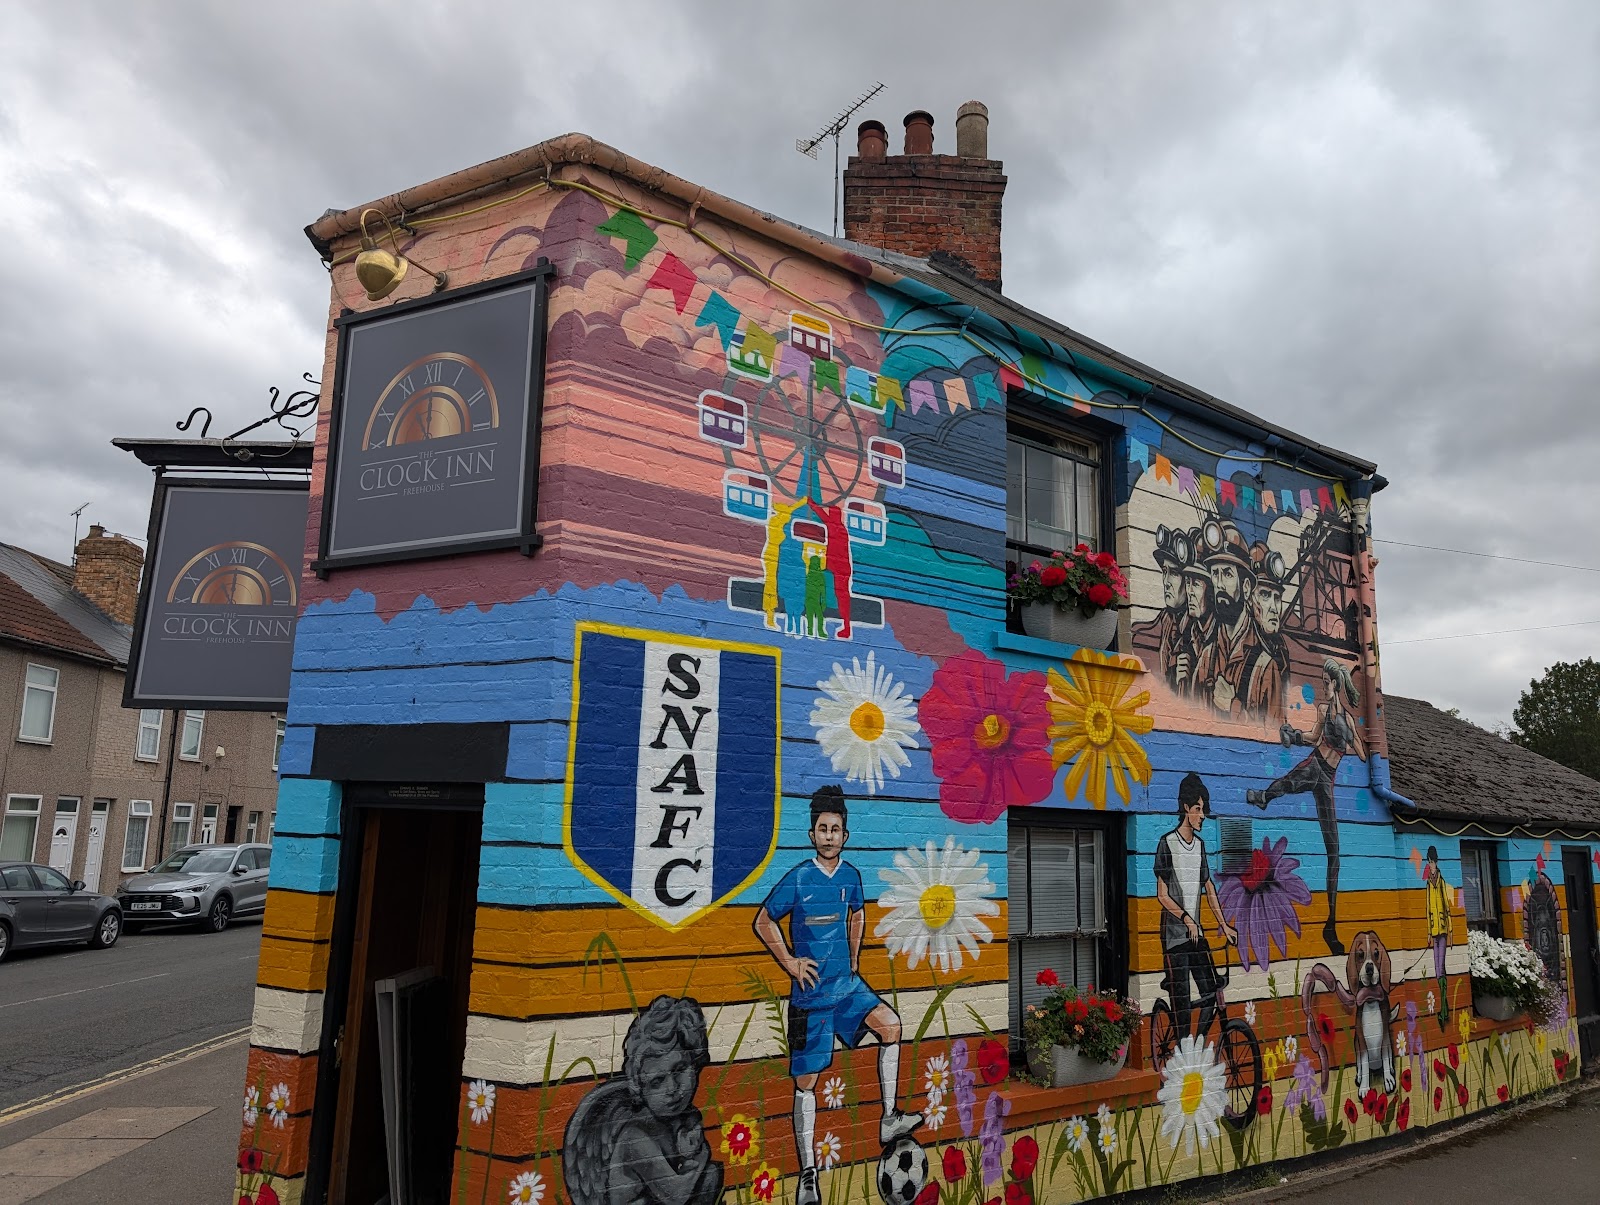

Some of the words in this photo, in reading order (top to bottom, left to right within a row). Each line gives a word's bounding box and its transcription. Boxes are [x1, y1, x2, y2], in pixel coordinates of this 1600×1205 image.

[398, 374, 416, 400] XI
[424, 361, 443, 385] XII
[452, 366, 465, 387] I
[467, 387, 486, 407] II
[360, 458, 439, 491] CLOCK
[446, 448, 496, 479] INN
[419, 450, 434, 460] THE
[403, 483, 446, 496] FREEHOUSE
[205, 552, 221, 571] XI
[229, 548, 248, 564] XII
[256, 555, 268, 570] I
[269, 574, 286, 587] II
[163, 617, 240, 636] CLOCK
[246, 619, 292, 637] INN
[650, 652, 712, 907] SNAFC
